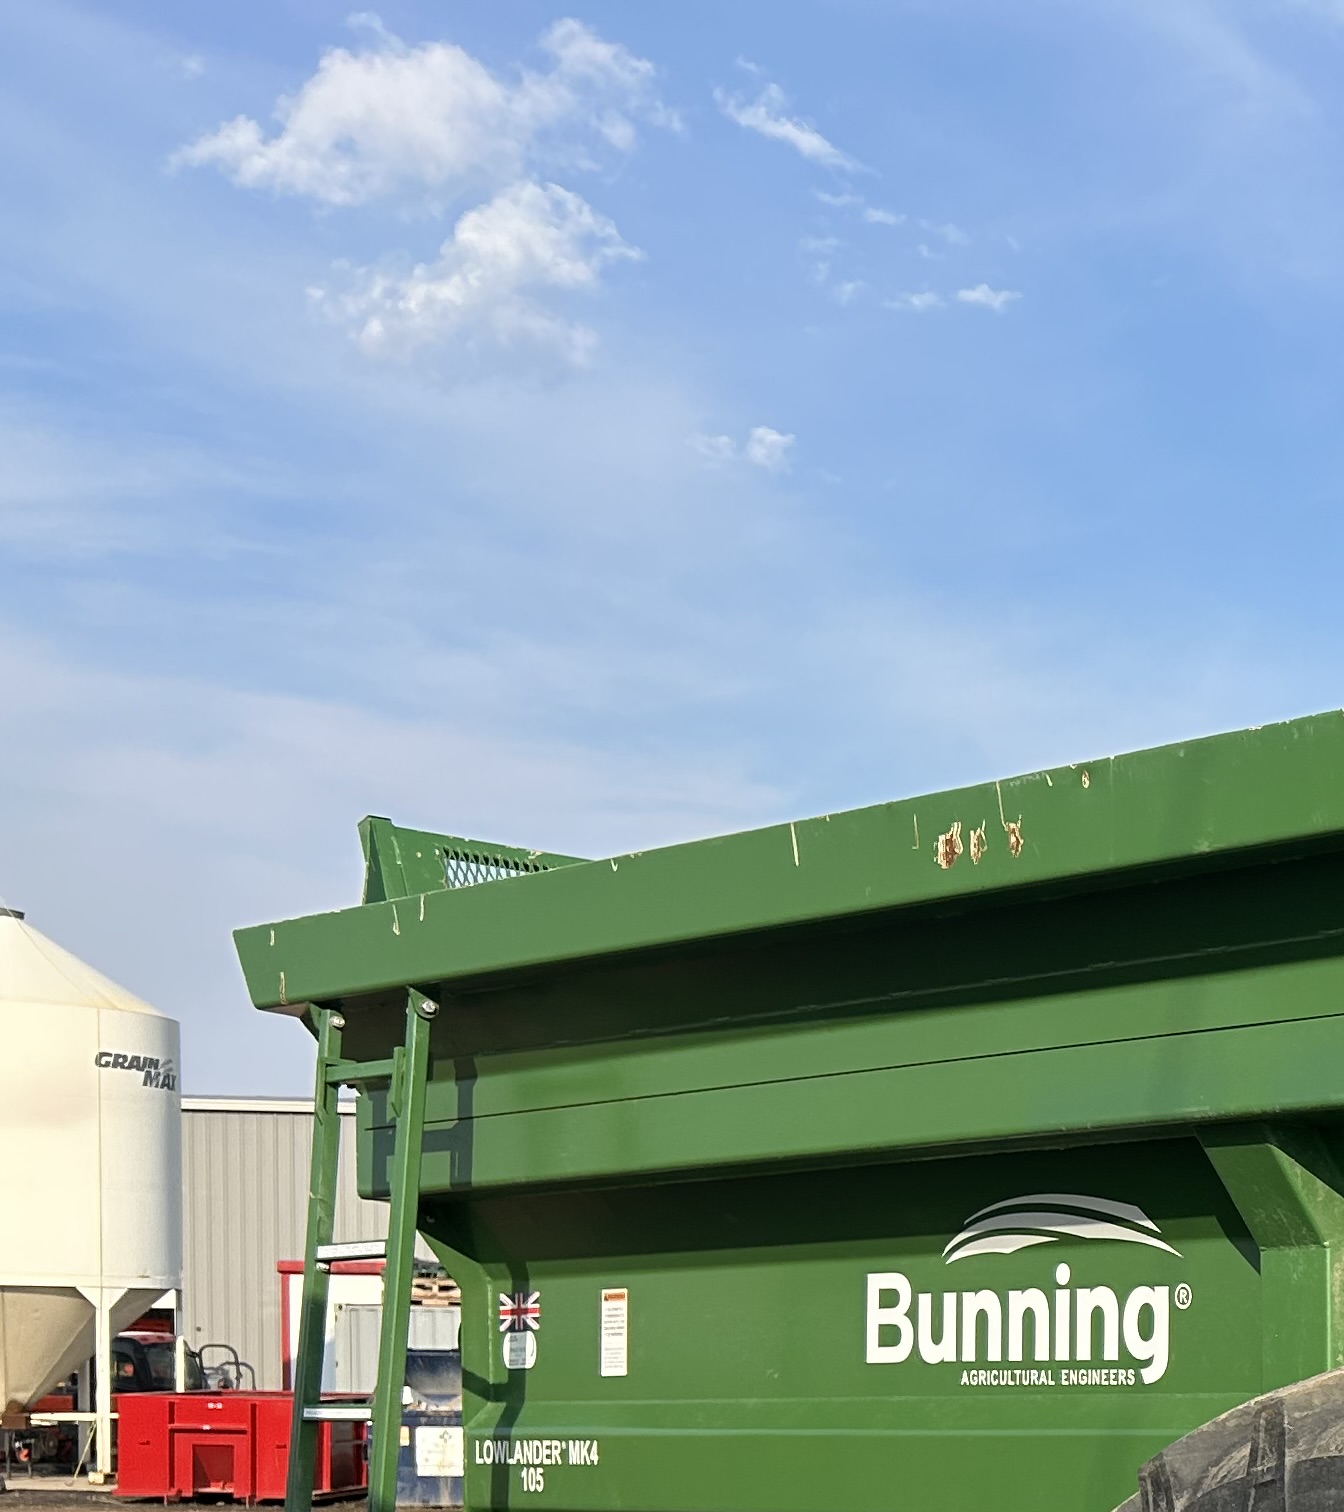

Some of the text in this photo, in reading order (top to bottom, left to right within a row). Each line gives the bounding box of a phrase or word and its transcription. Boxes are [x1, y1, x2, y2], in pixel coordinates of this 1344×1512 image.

[94, 1051, 160, 1072] GRAIN
[960, 1368, 1136, 1386] AGRICULTURAL ENGINEERS
[568, 1439, 599, 1465] MK4
[520, 1466, 544, 1493] 105
